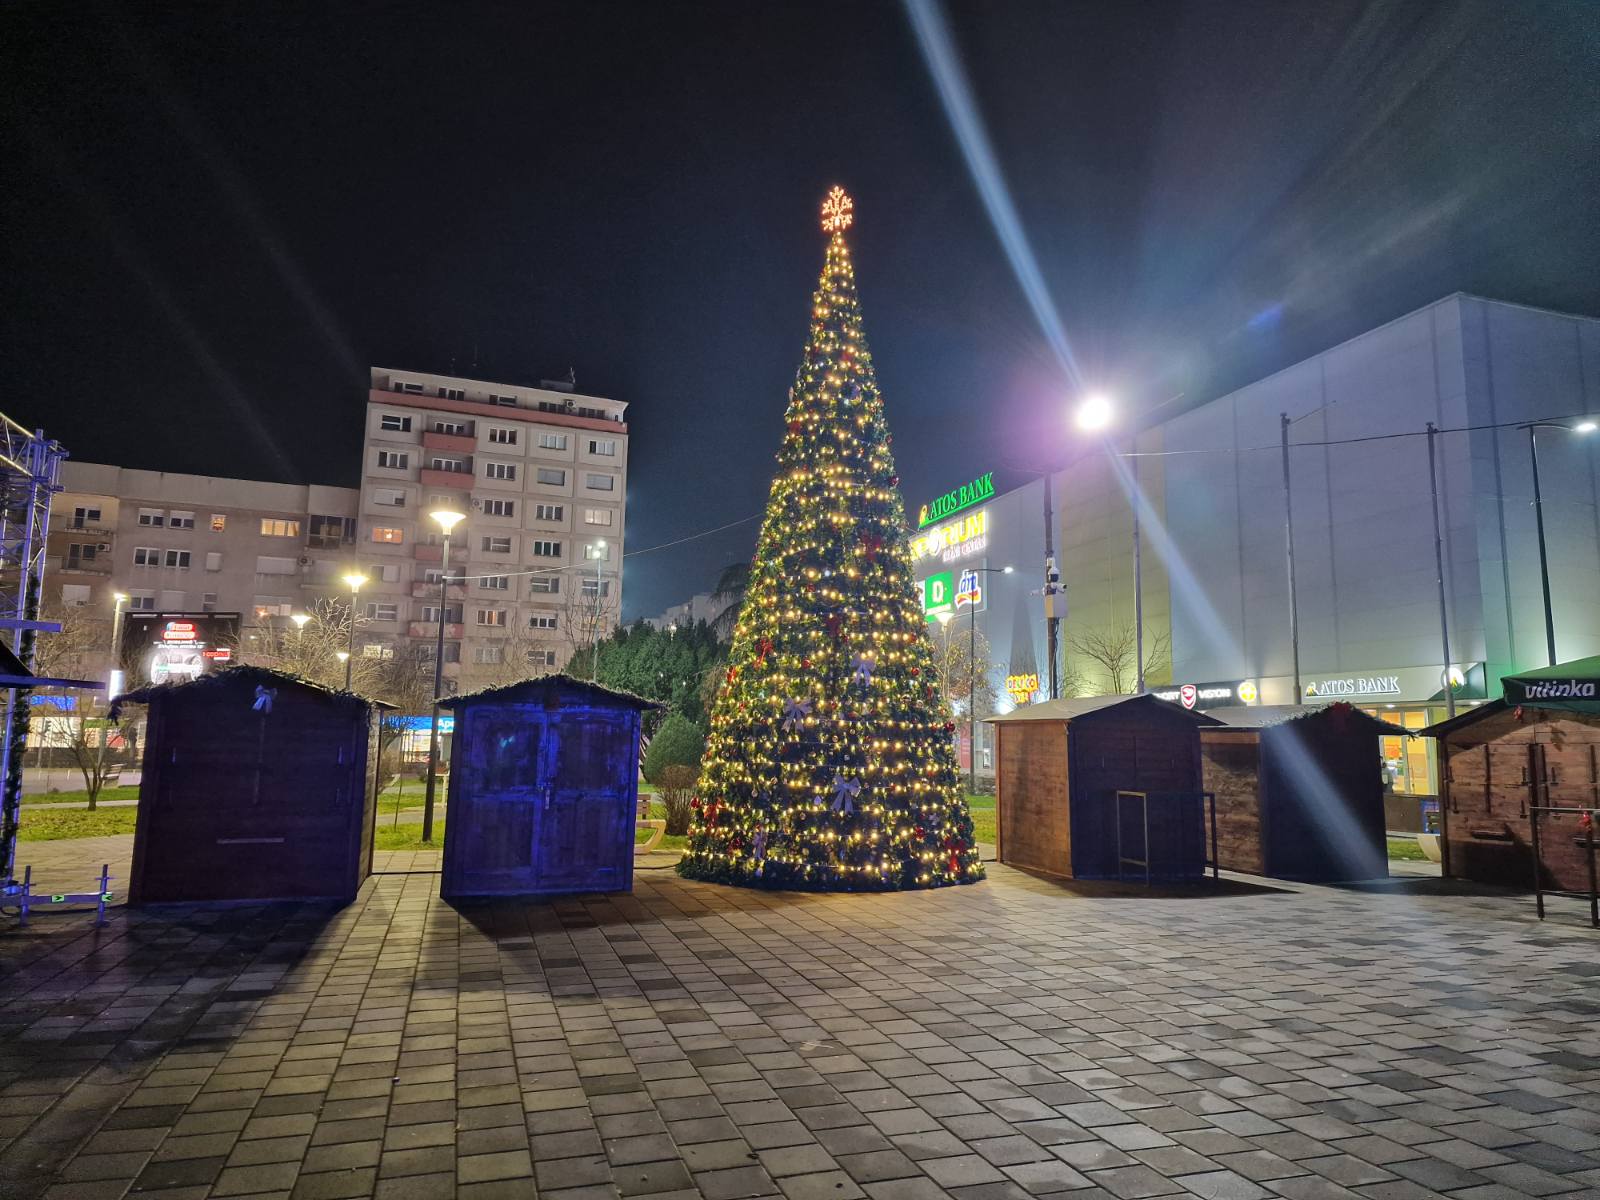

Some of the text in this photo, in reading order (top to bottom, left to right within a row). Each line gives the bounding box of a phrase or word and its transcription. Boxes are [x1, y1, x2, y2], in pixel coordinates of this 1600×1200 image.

[930, 472, 994, 519] ATOS BANK
[1198, 688, 1231, 699] VISION
[1321, 676, 1400, 695] ATOS BANK
[1525, 680, 1595, 699] vitinka
